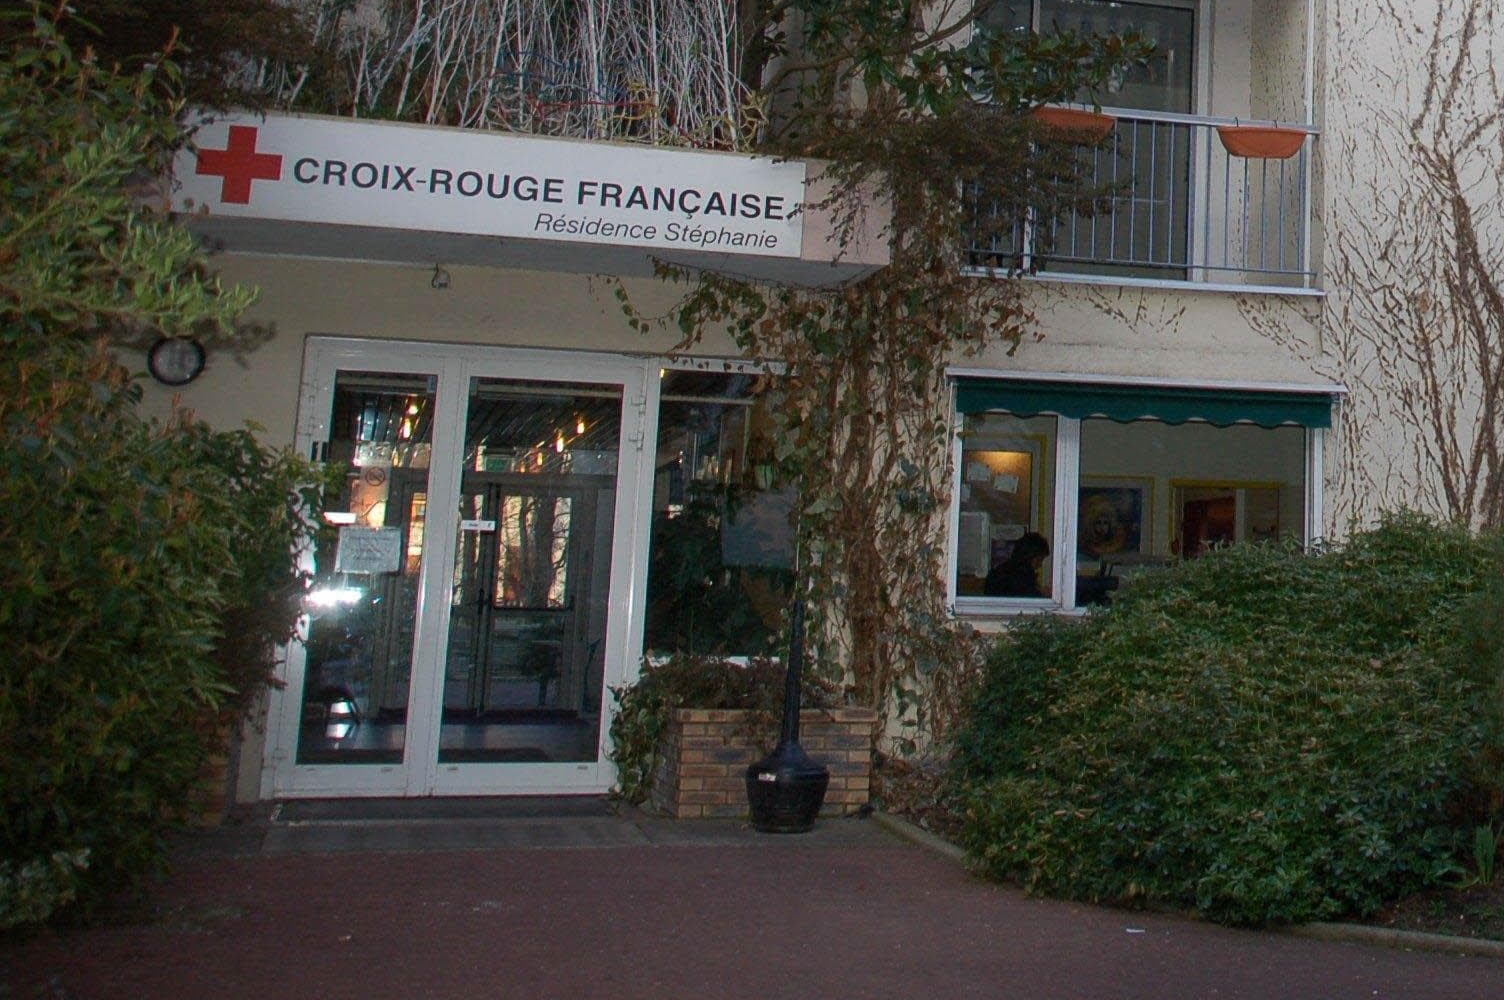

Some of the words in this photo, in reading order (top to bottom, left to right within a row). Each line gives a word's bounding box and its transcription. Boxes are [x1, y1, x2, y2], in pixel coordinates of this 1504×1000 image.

[293, 157, 564, 203] CROIX-ROUGE
[577, 180, 785, 221] FRANÇAISE
[534, 212, 657, 240] Résidence
[664, 222, 778, 248] Stéphanie
